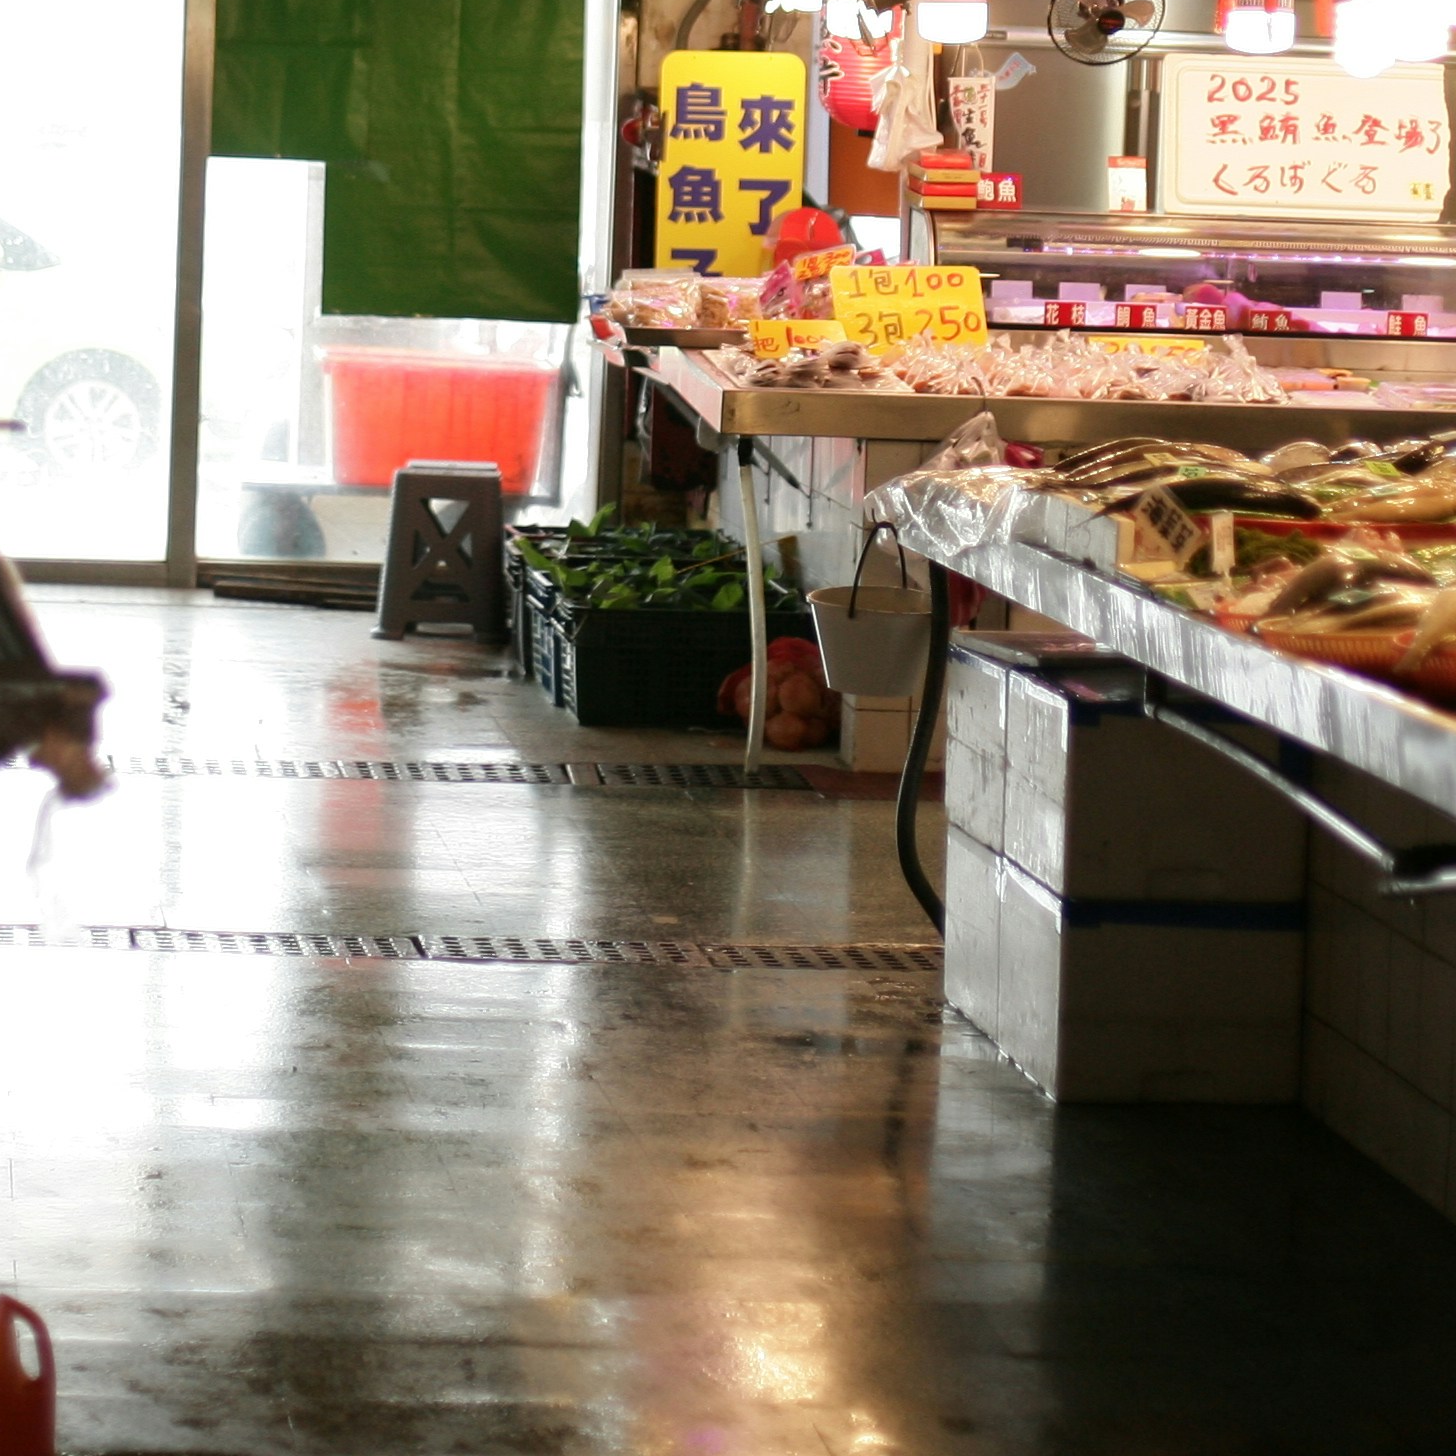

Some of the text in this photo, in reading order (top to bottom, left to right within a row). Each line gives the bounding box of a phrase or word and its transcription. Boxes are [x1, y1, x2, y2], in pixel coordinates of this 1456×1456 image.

[1207, 74, 1300, 105] 2025
[737, 95, 796, 235] 來了
[977, 178, 1017, 203] 鮑魚
[1046, 304, 1086, 325] 花枝
[1116, 306, 1156, 328] 鯛魚
[1185, 308, 1227, 330] 黃金魚
[1251, 313, 1291, 332] 鮪魚
[1388, 315, 1427, 337] 鮭魚
